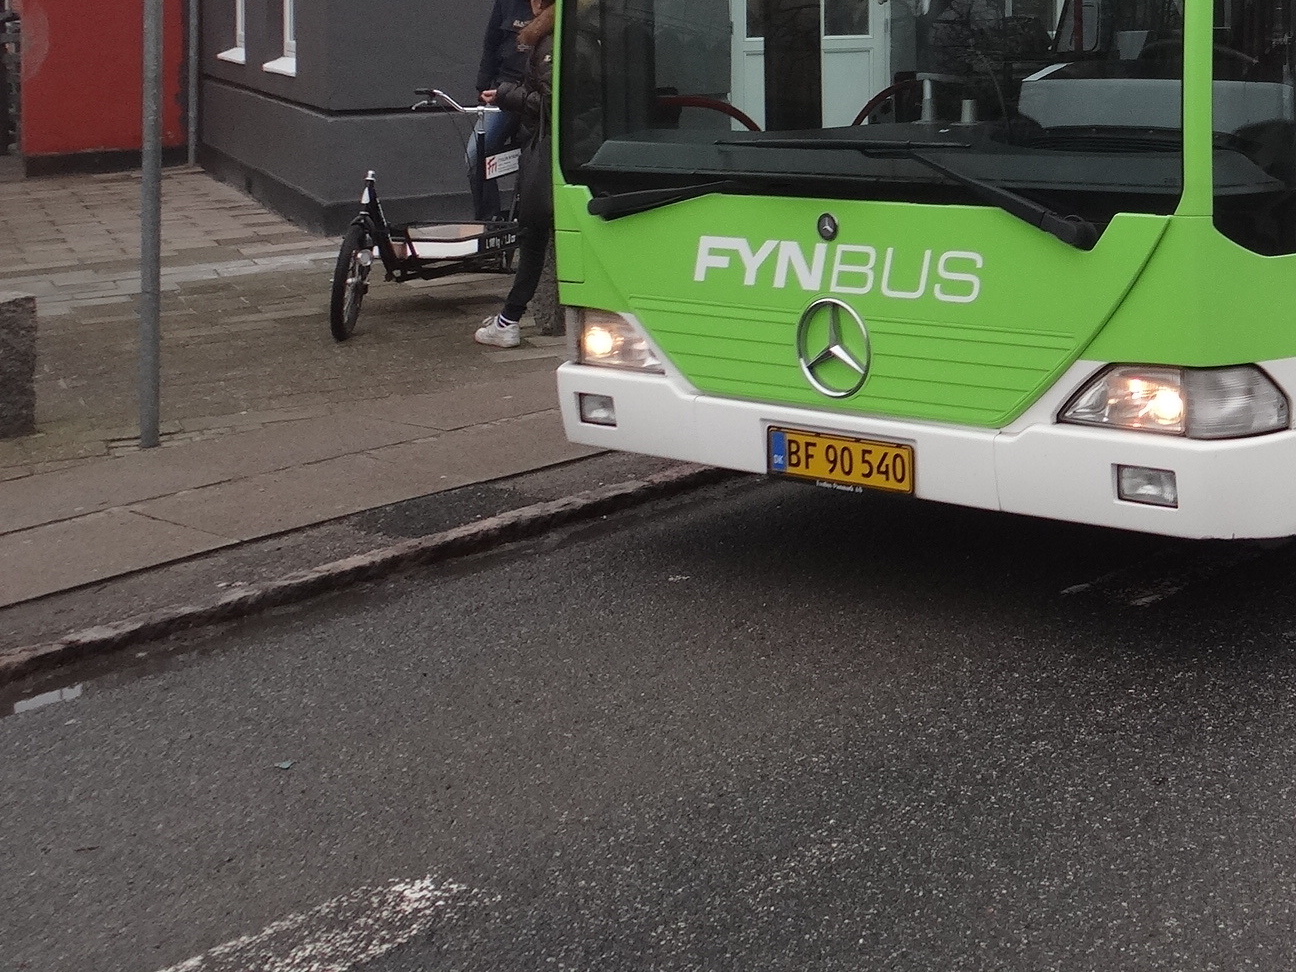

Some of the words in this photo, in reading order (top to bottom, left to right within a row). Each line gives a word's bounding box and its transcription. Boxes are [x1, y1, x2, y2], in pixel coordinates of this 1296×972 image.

[693, 235, 984, 304] FYNBUS
[787, 438, 817, 470] BF
[825, 444, 854, 476] 90
[861, 449, 906, 484] 540
